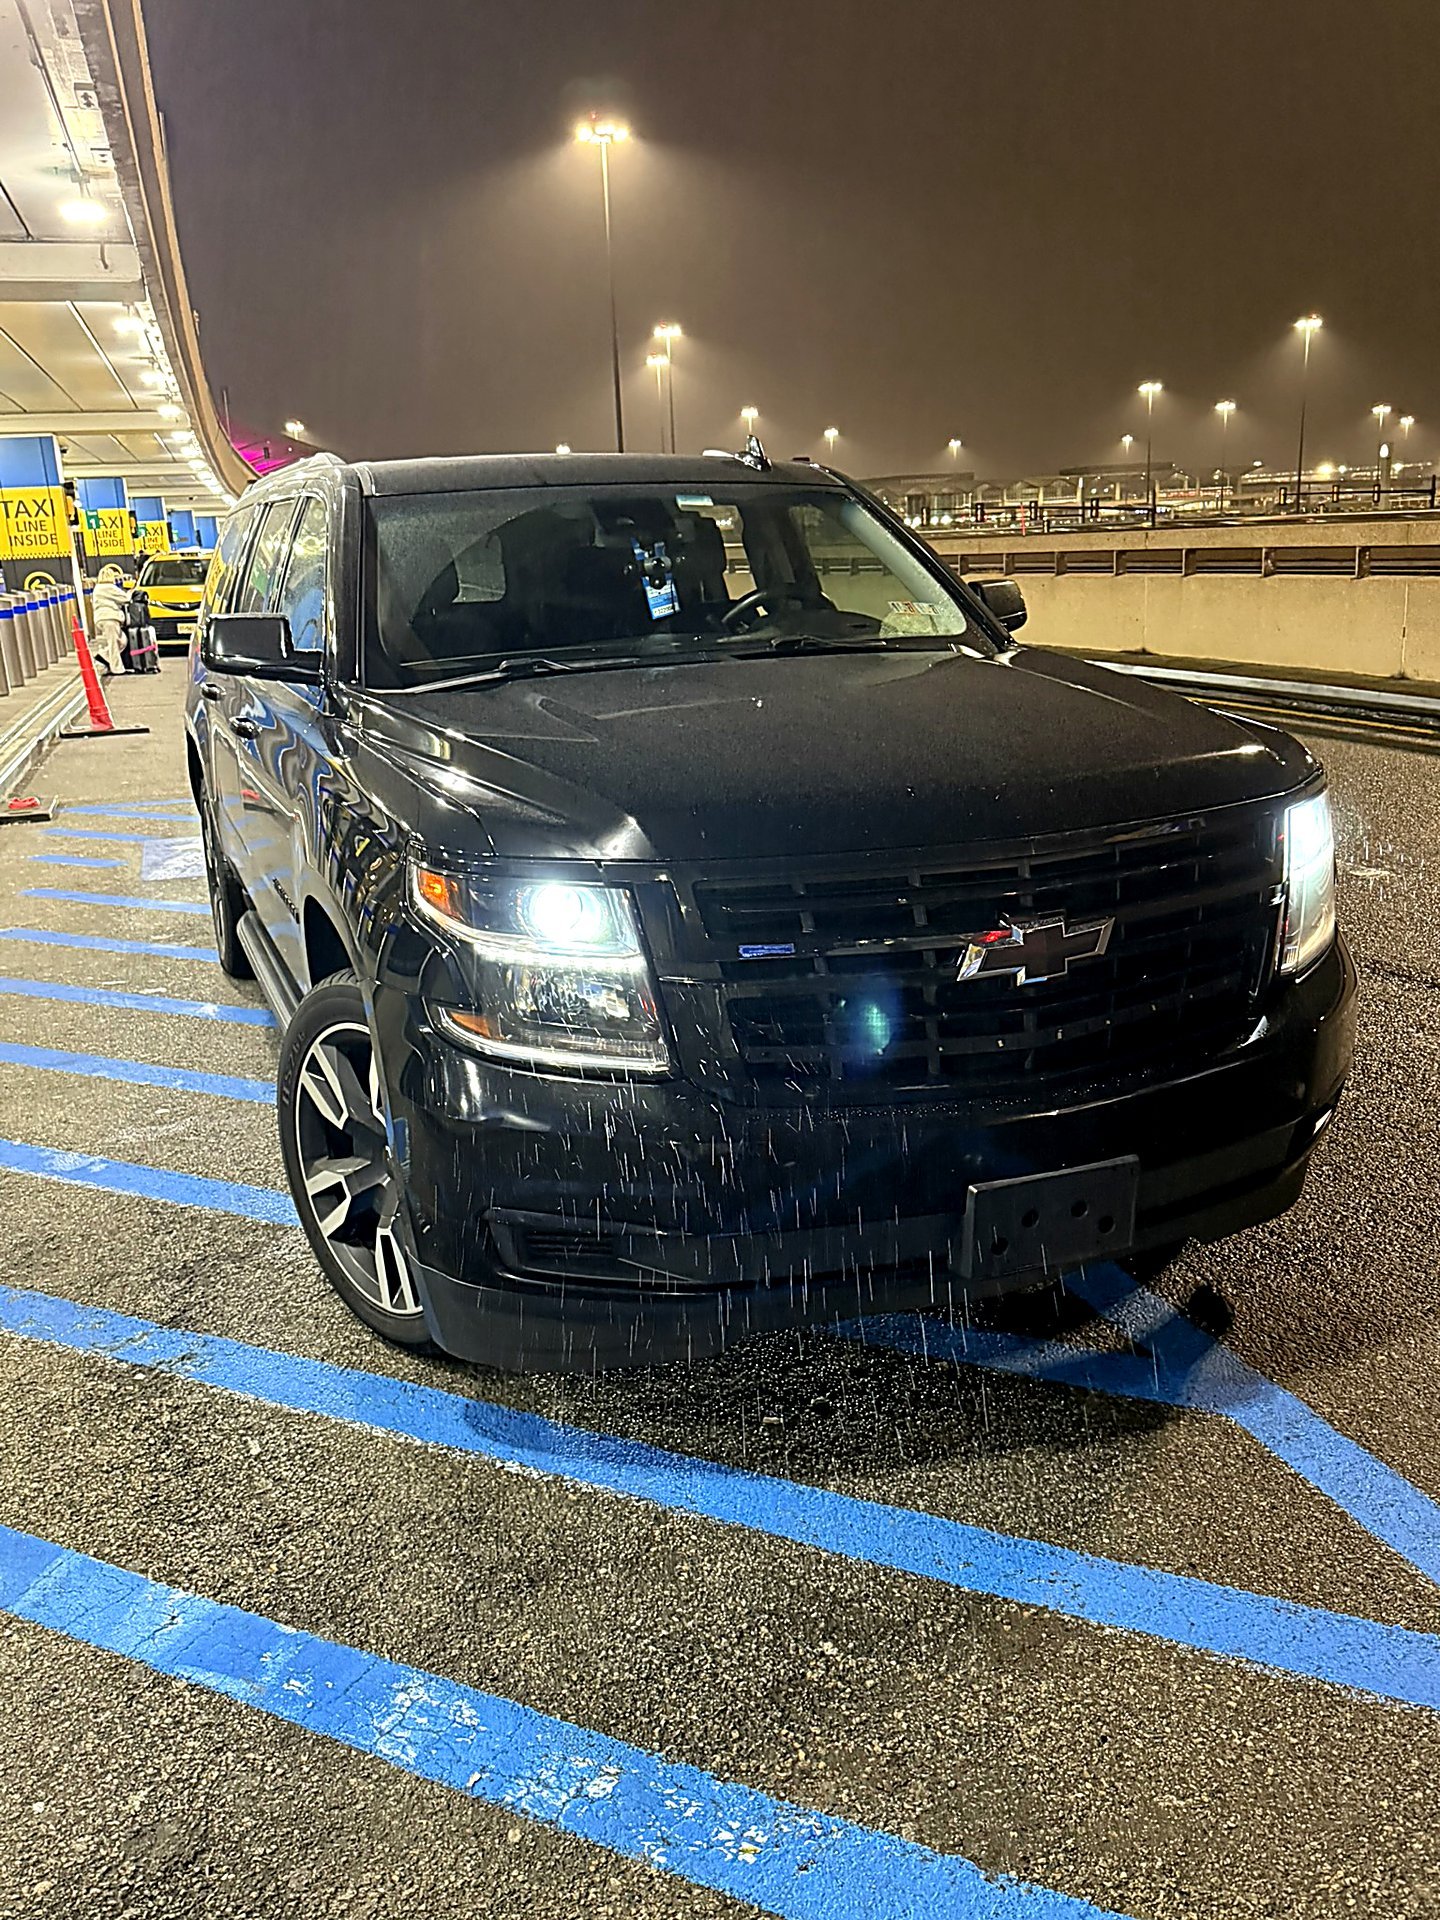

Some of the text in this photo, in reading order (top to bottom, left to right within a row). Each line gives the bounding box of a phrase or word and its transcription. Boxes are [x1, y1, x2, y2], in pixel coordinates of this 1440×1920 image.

[0, 498, 55, 519] TAXI
[16, 520, 47, 532] LINE
[98, 516, 124, 529] AXI
[9, 533, 58, 547] INSIDE
[97, 530, 118, 538] LINE
